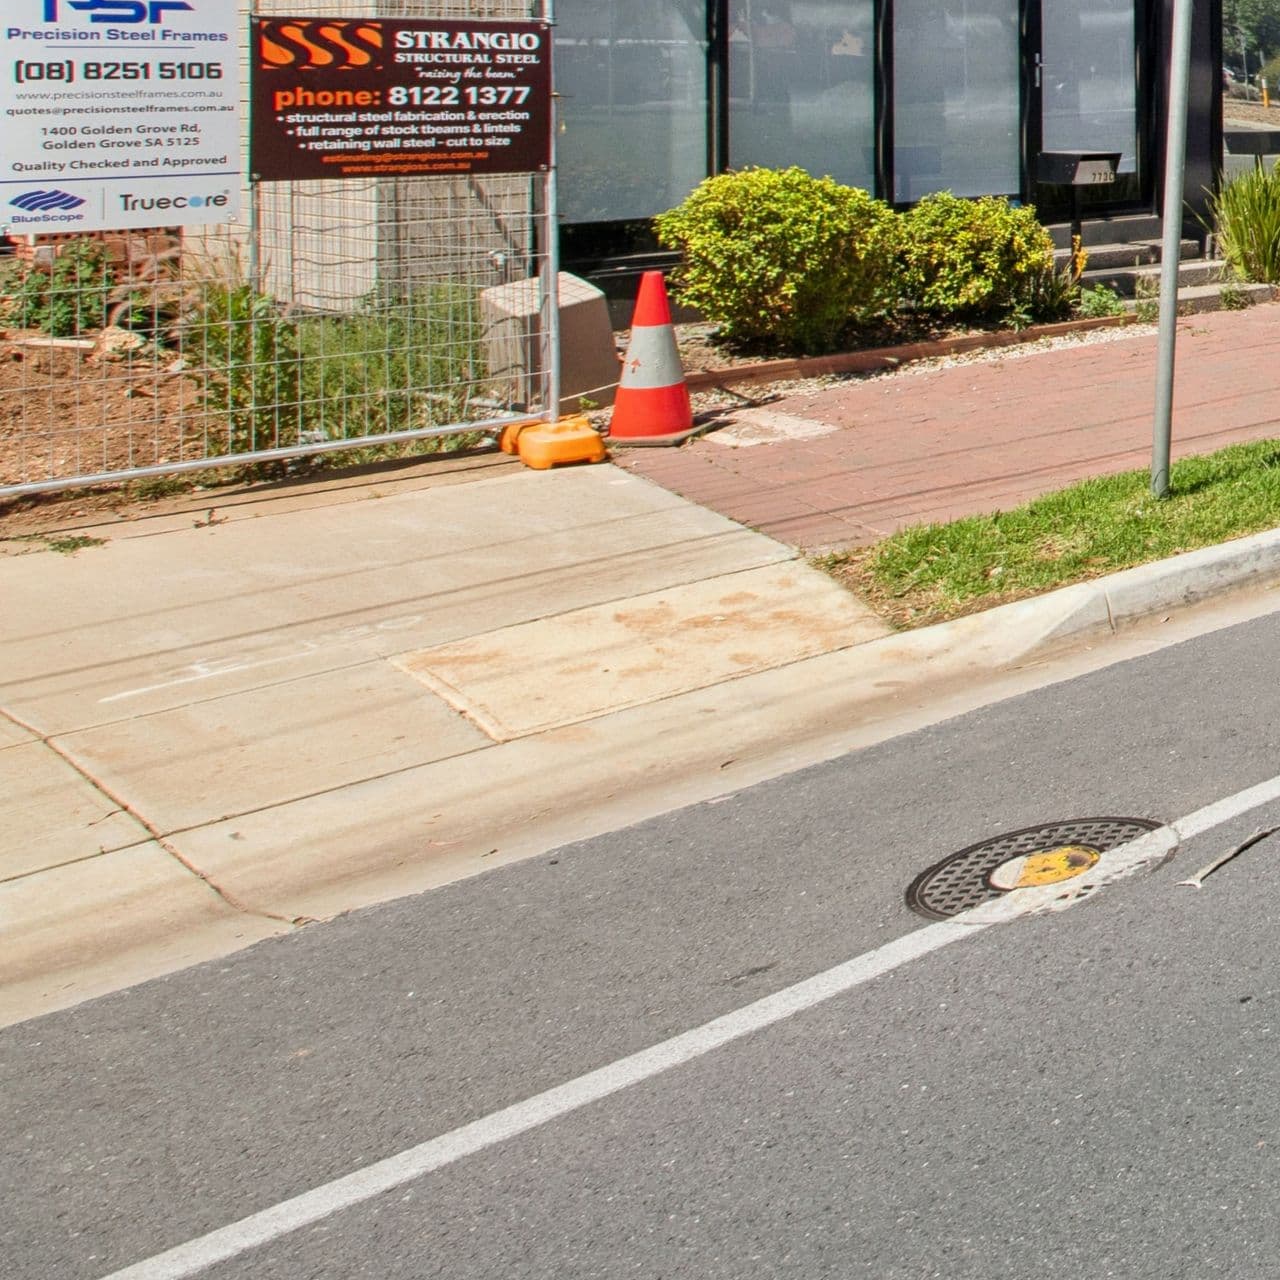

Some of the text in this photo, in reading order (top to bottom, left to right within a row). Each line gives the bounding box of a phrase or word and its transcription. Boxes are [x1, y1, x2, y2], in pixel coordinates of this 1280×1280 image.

[7, 28, 229, 42] Precision Steel Frames
[395, 31, 540, 51] STRANGIO
[394, 53, 540, 65] STRUCTURAL STEEL
[15, 60, 223, 83] (08) 8251 5106
[464, 66, 483, 78] the
[16, 90, 224, 102] www.precisionsteelframes.com.au
[274, 86, 531, 111] phone: 8122 1377
[6, 104, 235, 117] quotes@precisionsteelframes.com.au
[286, 109, 530, 123] structural steel fabrication & erection
[41, 123, 202, 136] 1400 Golden Grove Rd,
[296, 125, 320, 136] full
[321, 127, 363, 138] range
[365, 125, 380, 135] of
[381, 124, 419, 135] stock
[472, 123, 481, 133] &
[483, 122, 521, 133] lintels
[42, 137, 200, 150] Golden Grove SA 5125
[308, 138, 371, 151] retaining
[373, 138, 401, 149] wall
[402, 137, 436, 148] steel
[445, 137, 468, 147] cut
[469, 137, 483, 147] to
[484, 136, 511, 147] size
[12, 155, 227, 172] Quality Checked and Approved
[11, 213, 84, 224] BlueScope
